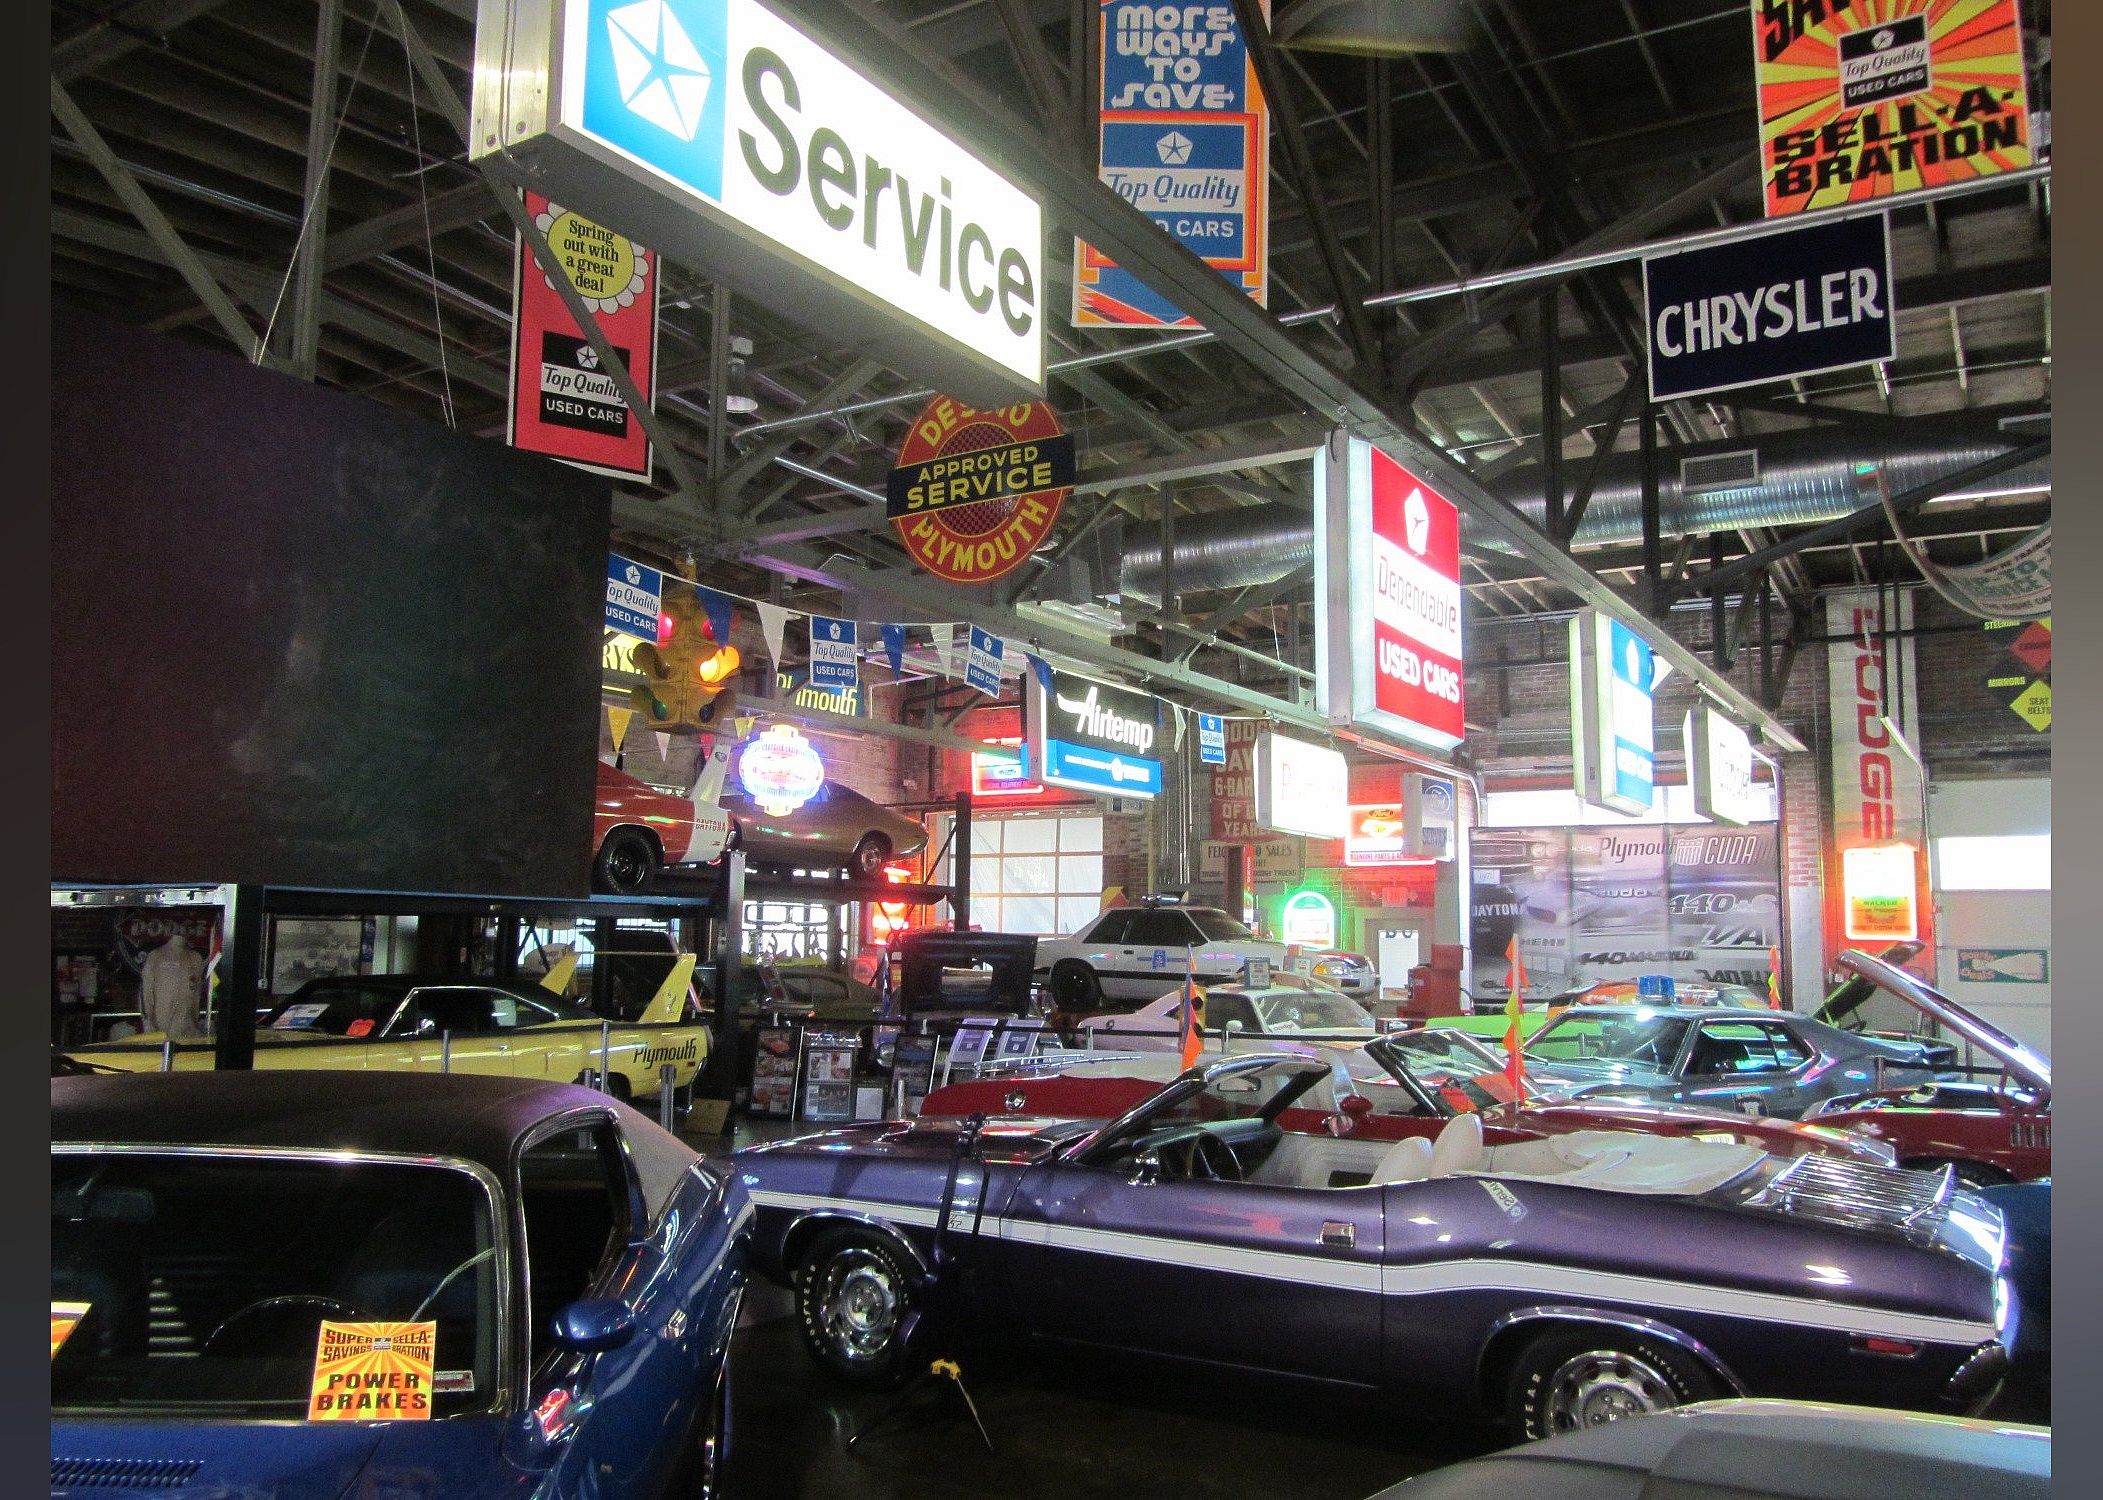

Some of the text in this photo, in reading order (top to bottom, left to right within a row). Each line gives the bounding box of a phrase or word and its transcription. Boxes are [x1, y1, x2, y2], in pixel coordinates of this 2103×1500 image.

[1843, 47, 1926, 79] Top Quality
[1847, 66, 1926, 98] USED CARS
[1775, 114, 2018, 199] BRATION
[737, 46, 1035, 337] Service
[1106, 173, 1240, 208] Top Quality
[569, 219, 615, 248] Spring
[1176, 219, 1235, 238] CARS
[563, 237, 619, 263] out with
[565, 255, 615, 278] a great
[575, 273, 604, 293] deal
[1655, 266, 1885, 359] CHRYSLER
[543, 366, 572, 392] Top
[546, 398, 624, 425] USED CARS
[918, 446, 1039, 483] APPROVED
[906, 461, 1053, 510] SERVICE
[910, 497, 1050, 573] PLYMOUTH
[624, 588, 658, 617] Quality
[1378, 555, 1457, 634] Dependable
[605, 605, 657, 632] USED CARS
[814, 642, 856, 663] Top Quality
[815, 665, 855, 678] USED CARS
[1379, 637, 1461, 704] USED CARS
[1057, 686, 1154, 755] Airtemp
[1852, 608, 1894, 839] DODGE
[1704, 835, 1758, 865] CUDA
[633, 1037, 697, 1070] Plymouth
[325, 1328, 373, 1345] SUPER
[323, 1345, 373, 1363] SAVINGS
[392, 1346, 430, 1362] BRATION
[328, 1372, 420, 1390] POWER
[316, 1392, 427, 1410] BRAKES
